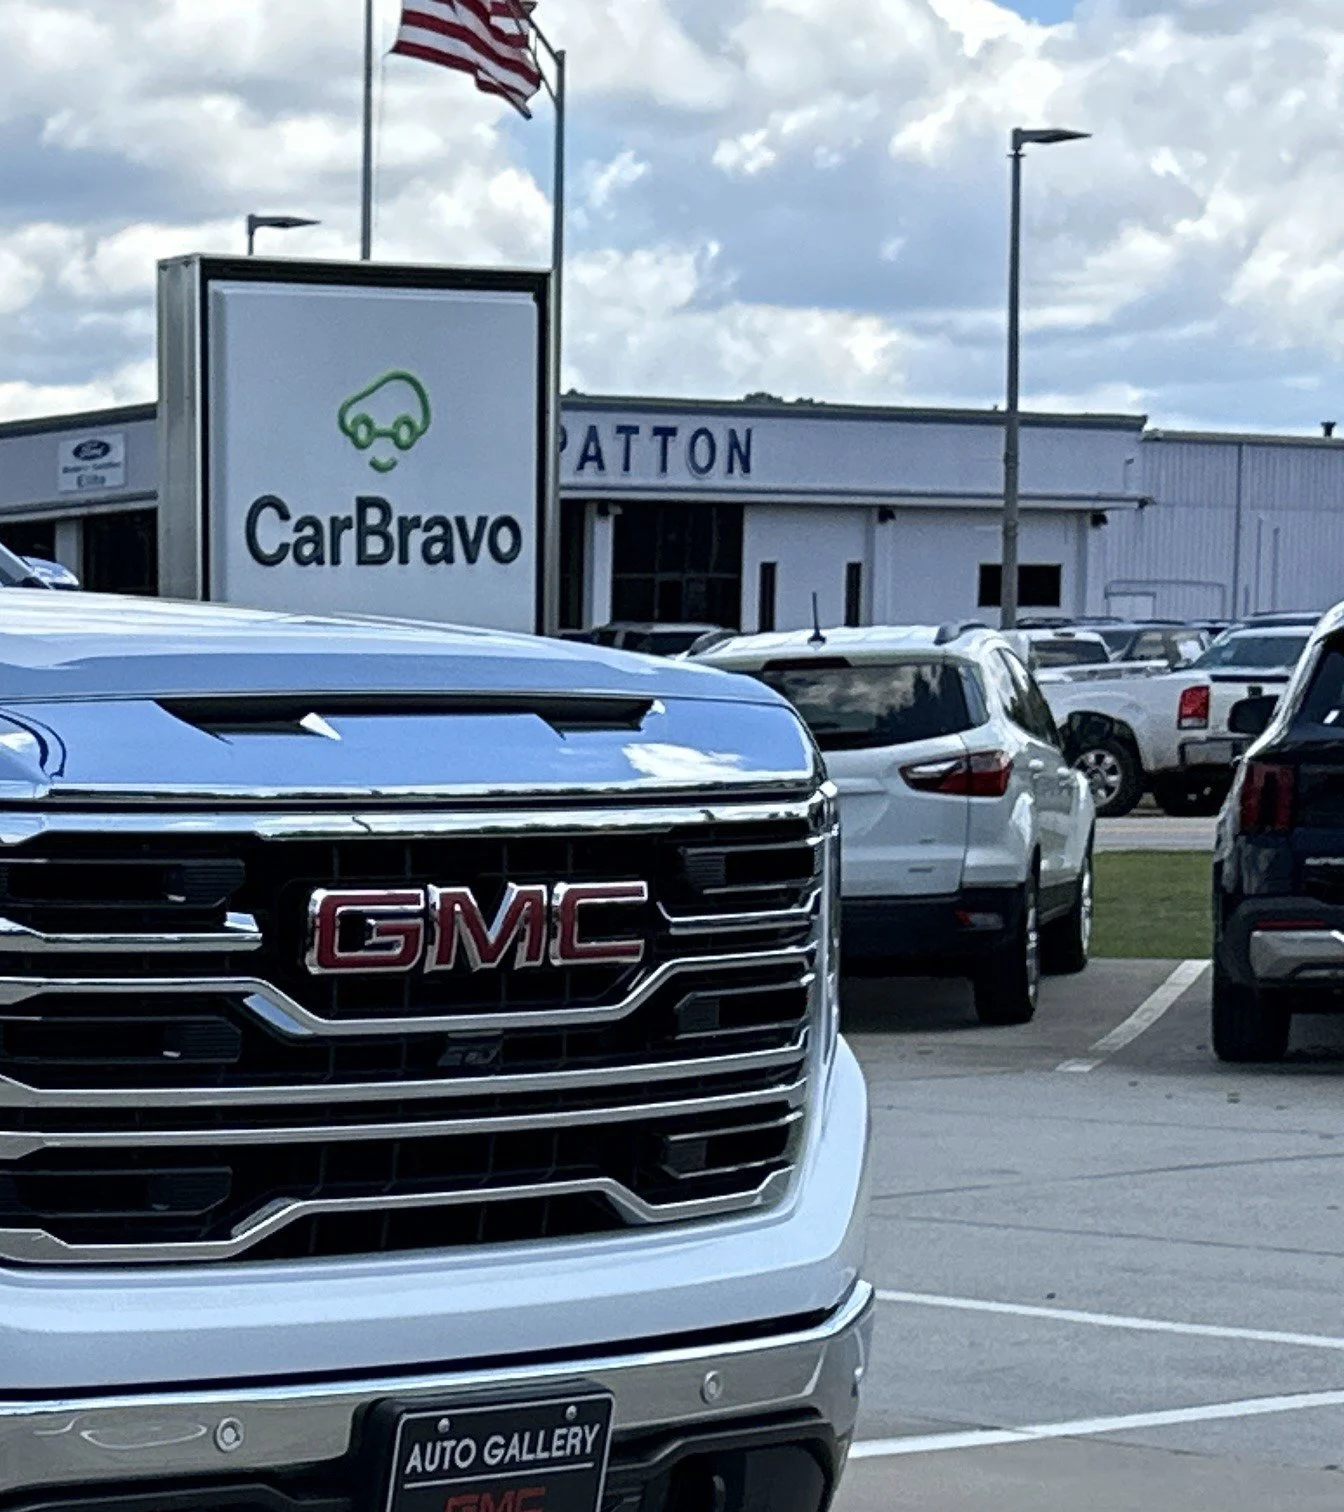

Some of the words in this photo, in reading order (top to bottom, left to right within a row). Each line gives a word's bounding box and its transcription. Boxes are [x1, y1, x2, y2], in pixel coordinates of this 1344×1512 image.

[244, 494, 523, 567] CarBravo
[306, 880, 649, 975] GMC
[404, 1437, 477, 1475] AUTO
[482, 1422, 601, 1467] GALLERY
